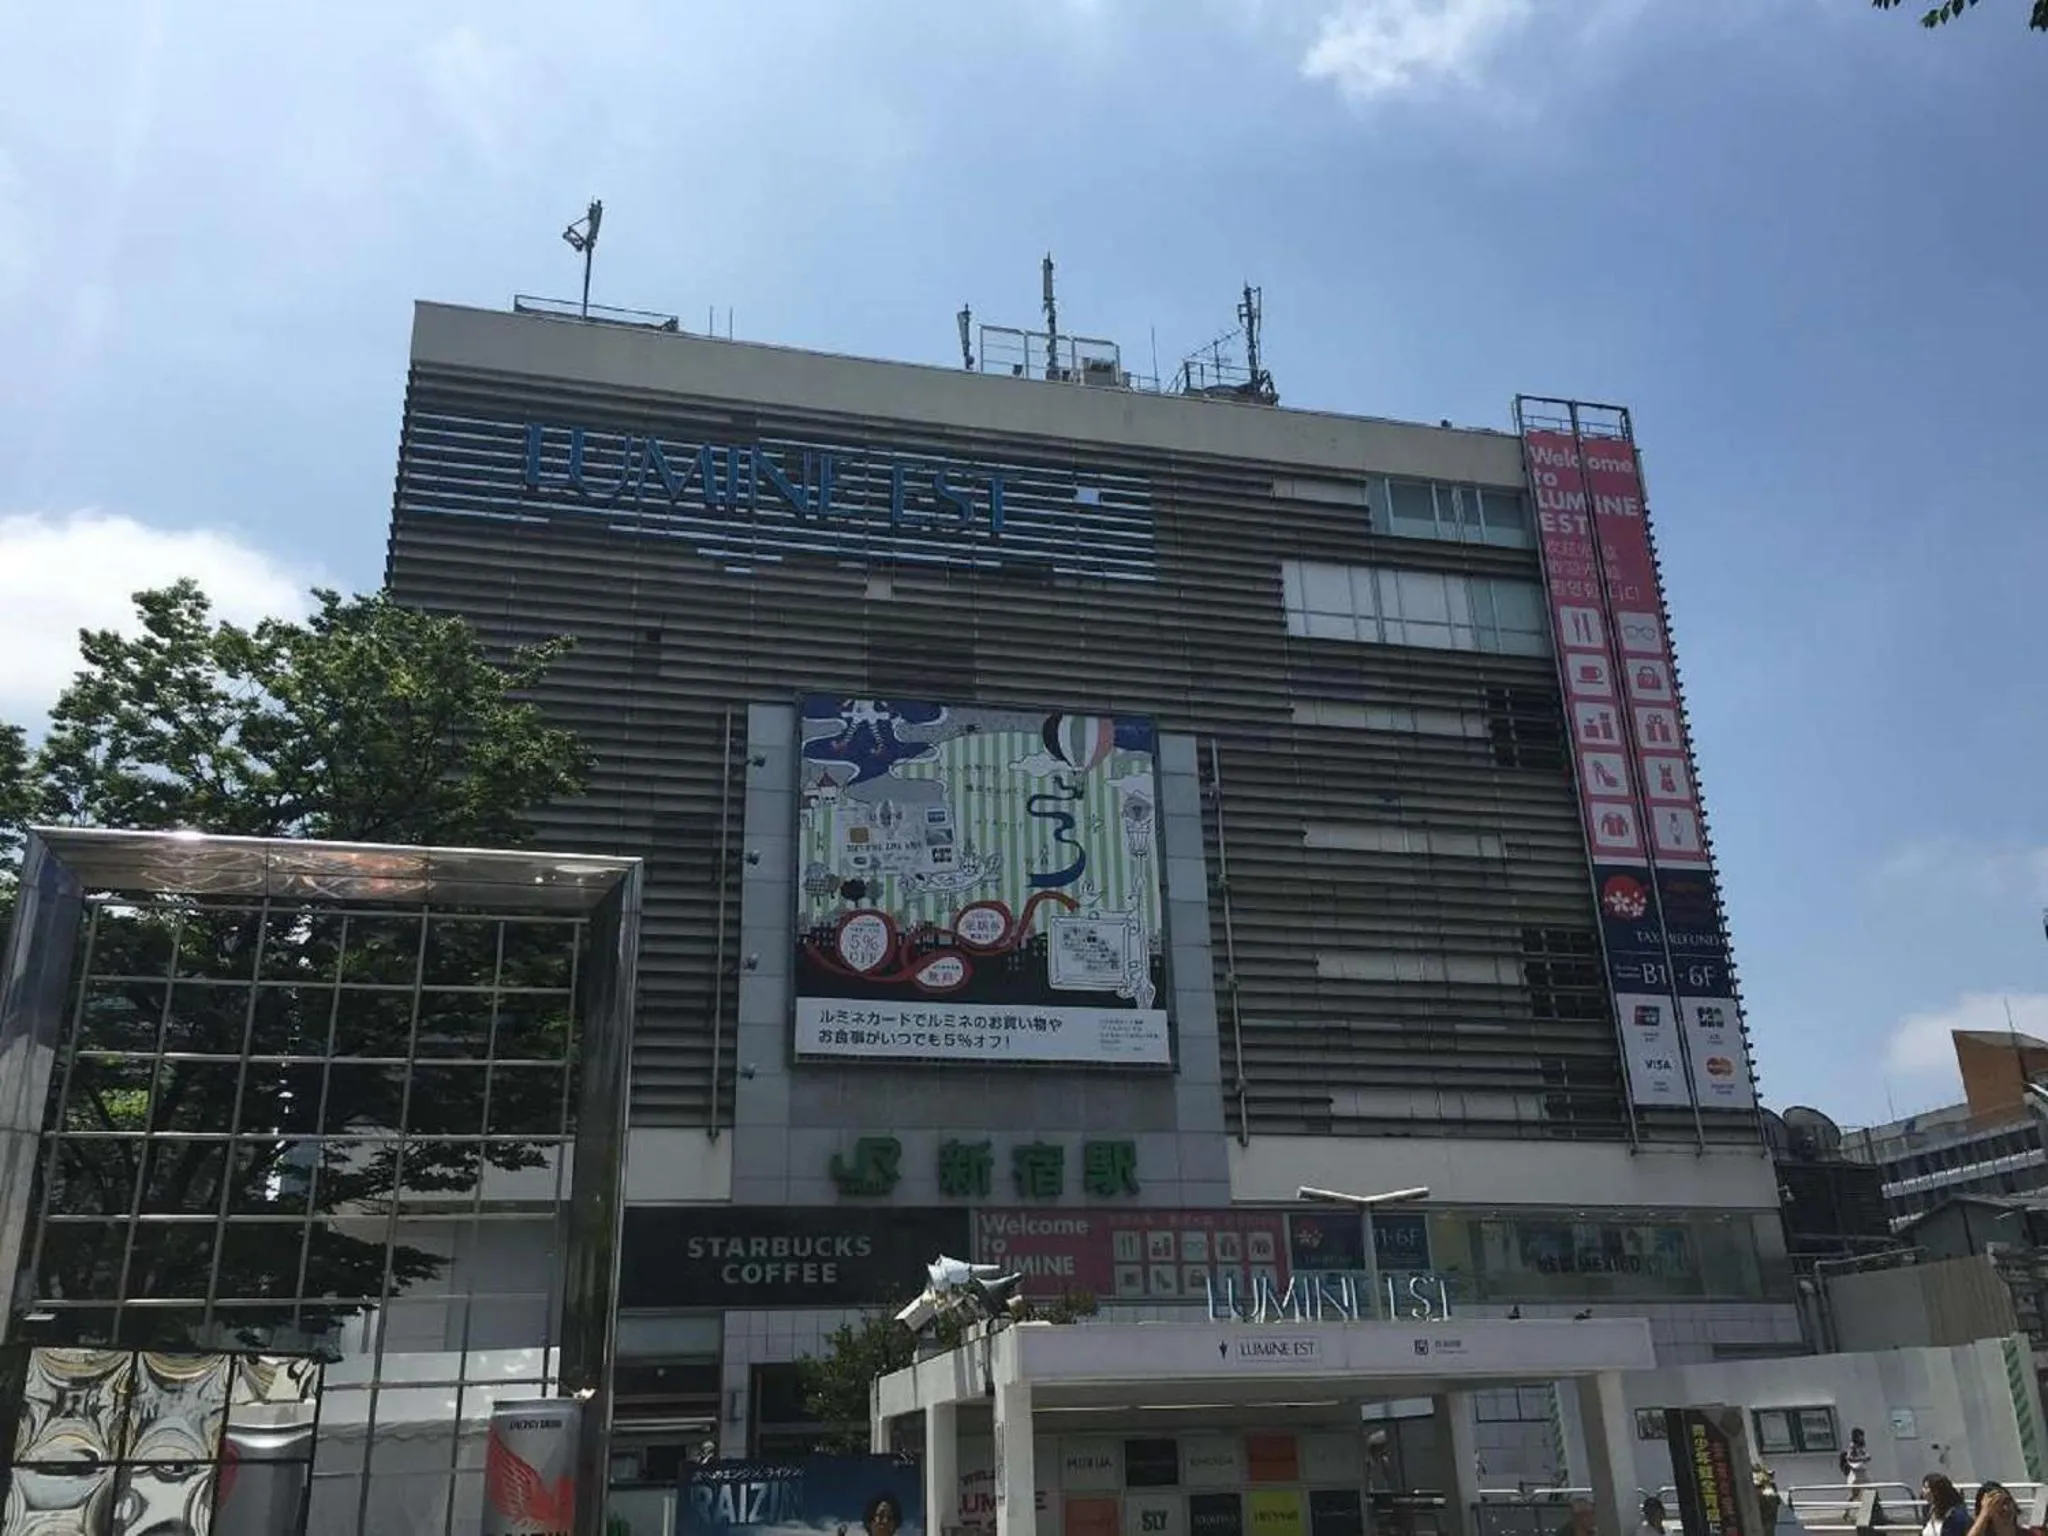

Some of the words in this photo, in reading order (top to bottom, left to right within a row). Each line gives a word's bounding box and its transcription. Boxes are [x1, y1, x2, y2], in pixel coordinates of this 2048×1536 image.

[1531, 446, 1633, 473] Welcome
[524, 422, 850, 518] LUMINE
[890, 461, 1020, 537] EST
[1534, 467, 1558, 487] to
[1538, 489, 1639, 517] LUMINE
[1542, 513, 1588, 535] EST
[819, 1008, 1063, 1034] ルミネカードでルミネのお買い物や
[1645, 1059, 1672, 1071] VISA
[831, 1136, 902, 1195] JR
[938, 1138, 1141, 1198] 新宿駅
[982, 1213, 1089, 1236] Welcome
[686, 1235, 873, 1258] STARBUCKS
[982, 1235, 1007, 1256] to
[720, 1262, 839, 1285] COFFEE
[1240, 1341, 1292, 1357] LUMINE
[1293, 1341, 1316, 1356] EST
[1141, 1509, 1169, 1532] SLY
